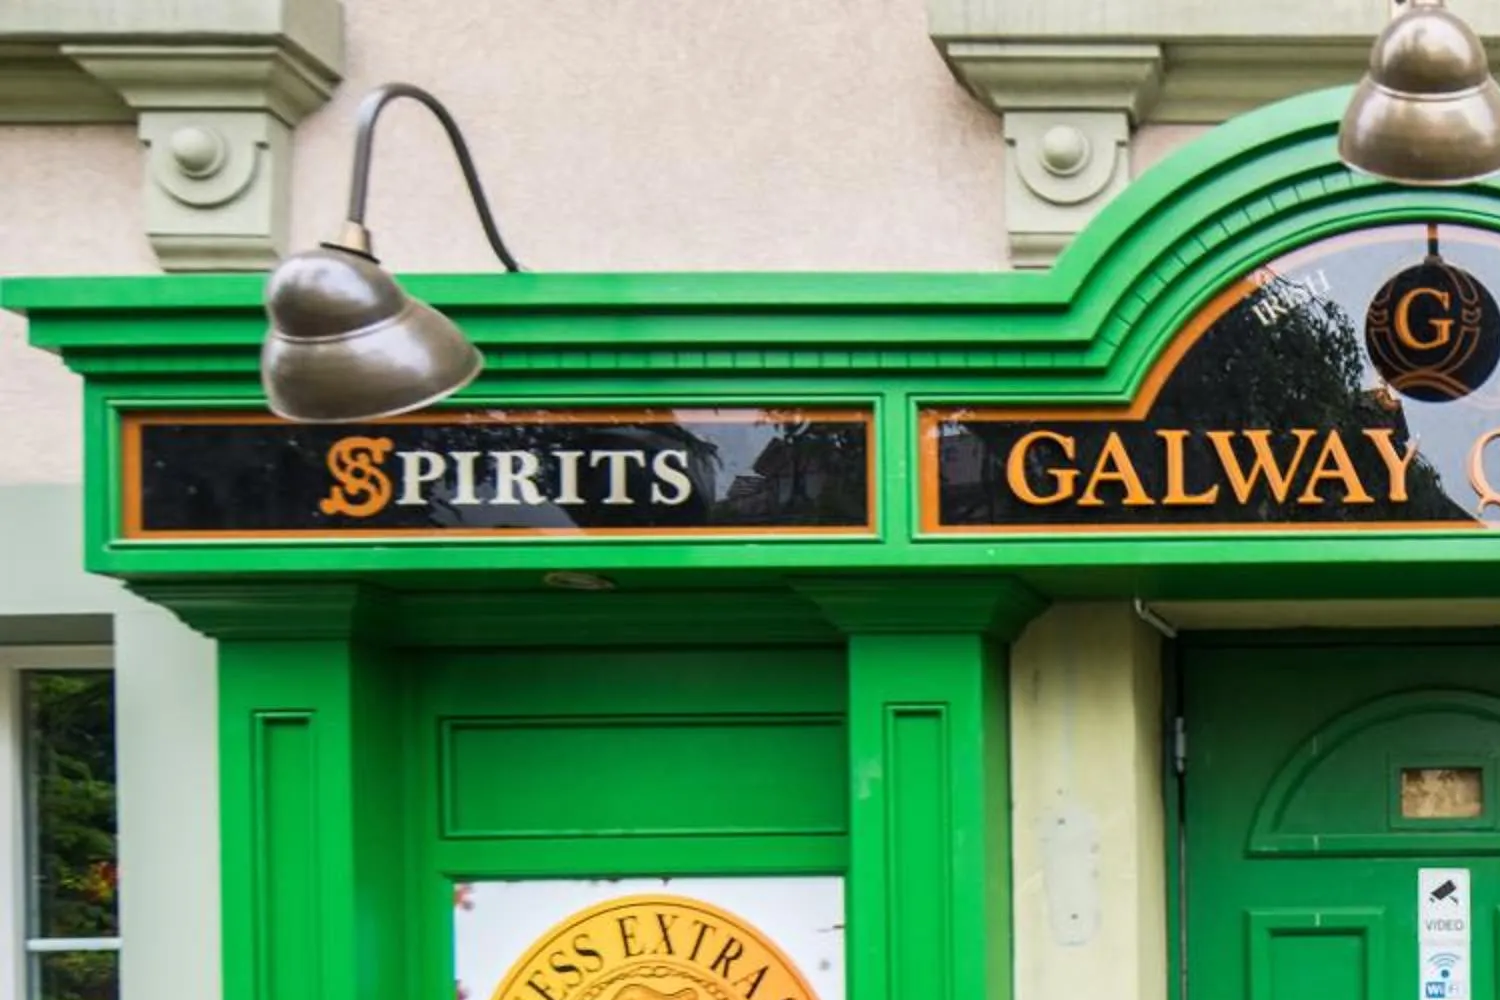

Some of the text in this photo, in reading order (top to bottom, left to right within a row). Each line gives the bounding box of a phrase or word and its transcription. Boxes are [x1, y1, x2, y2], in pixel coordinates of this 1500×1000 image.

[1394, 287, 1455, 350] G
[319, 435, 691, 518] SPIRITS
[1005, 428, 1422, 508] GALWAY
[616, 912, 770, 1000] EXTRA
[1425, 919, 1465, 932] VIDEO
